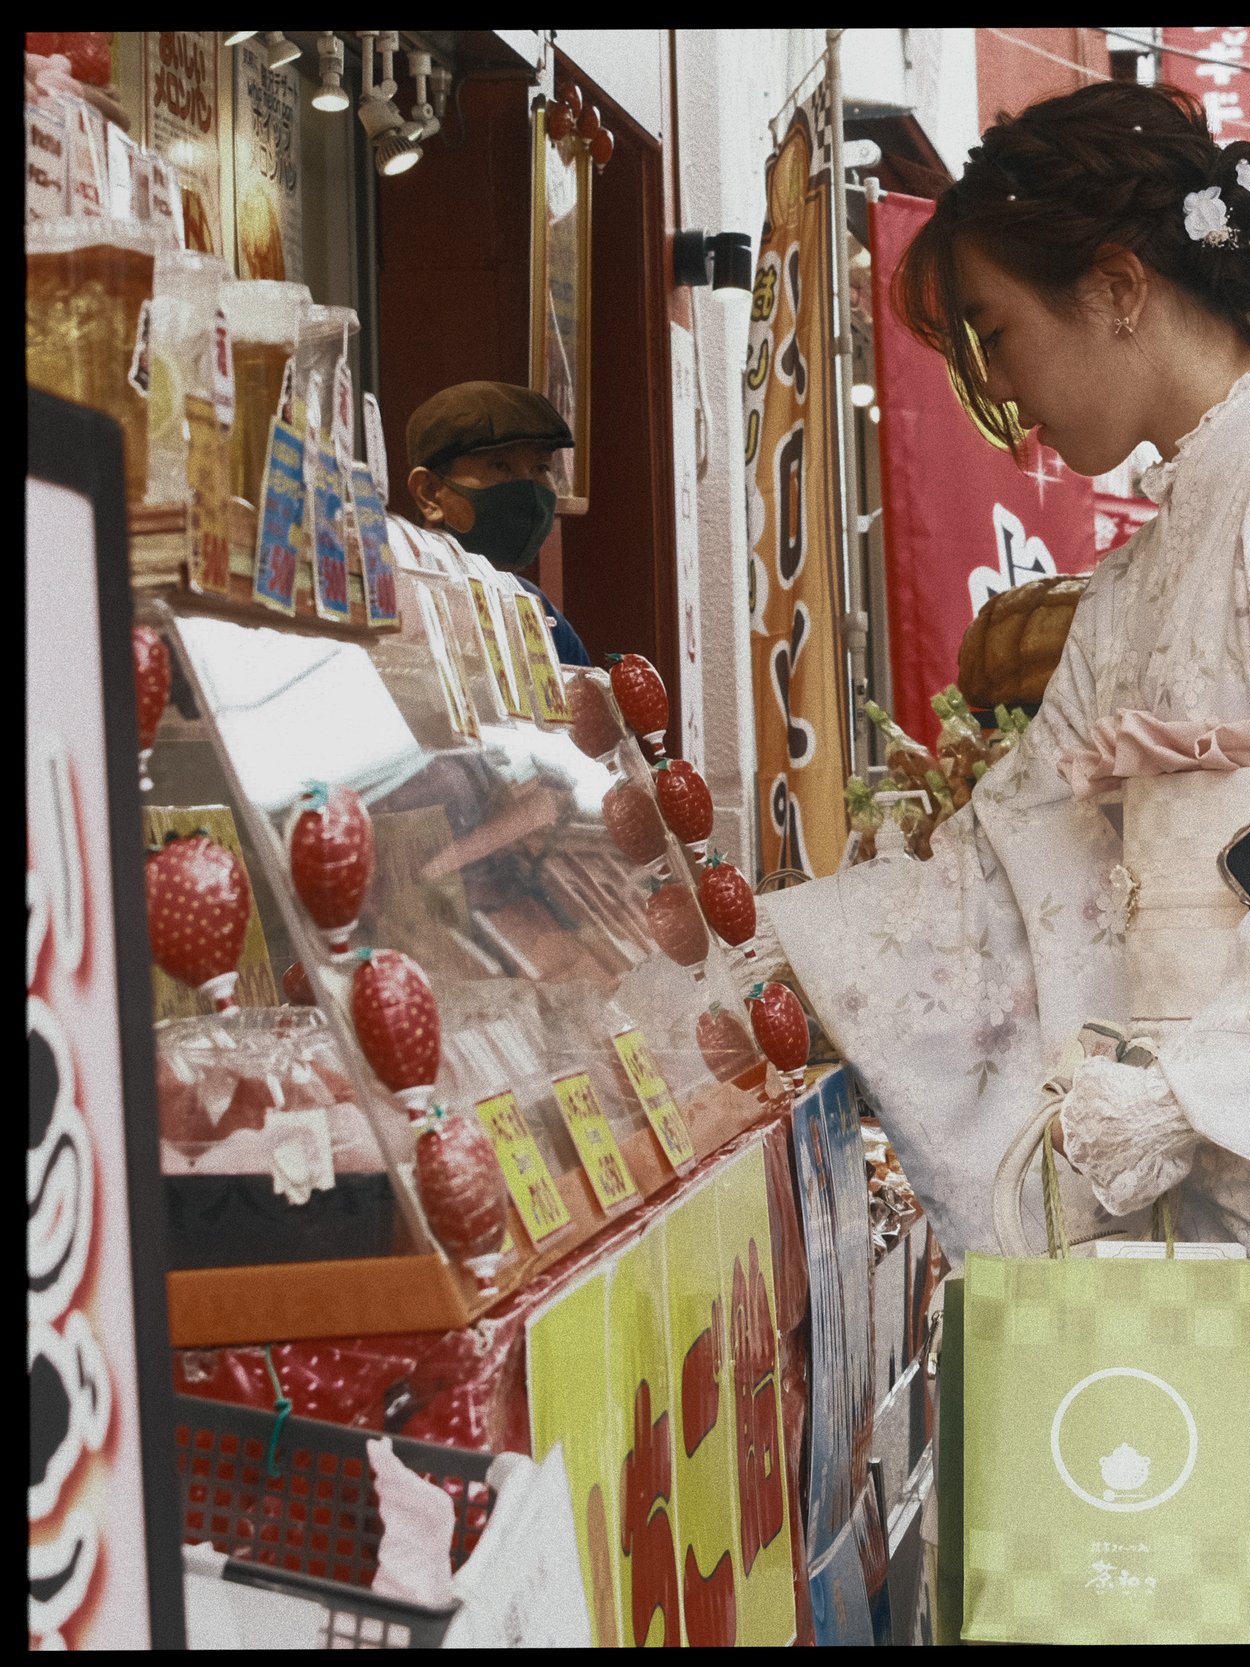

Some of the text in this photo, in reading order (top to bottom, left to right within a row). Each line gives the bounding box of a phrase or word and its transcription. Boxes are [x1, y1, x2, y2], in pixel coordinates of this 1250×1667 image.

[154, 66, 212, 134] メロンパン
